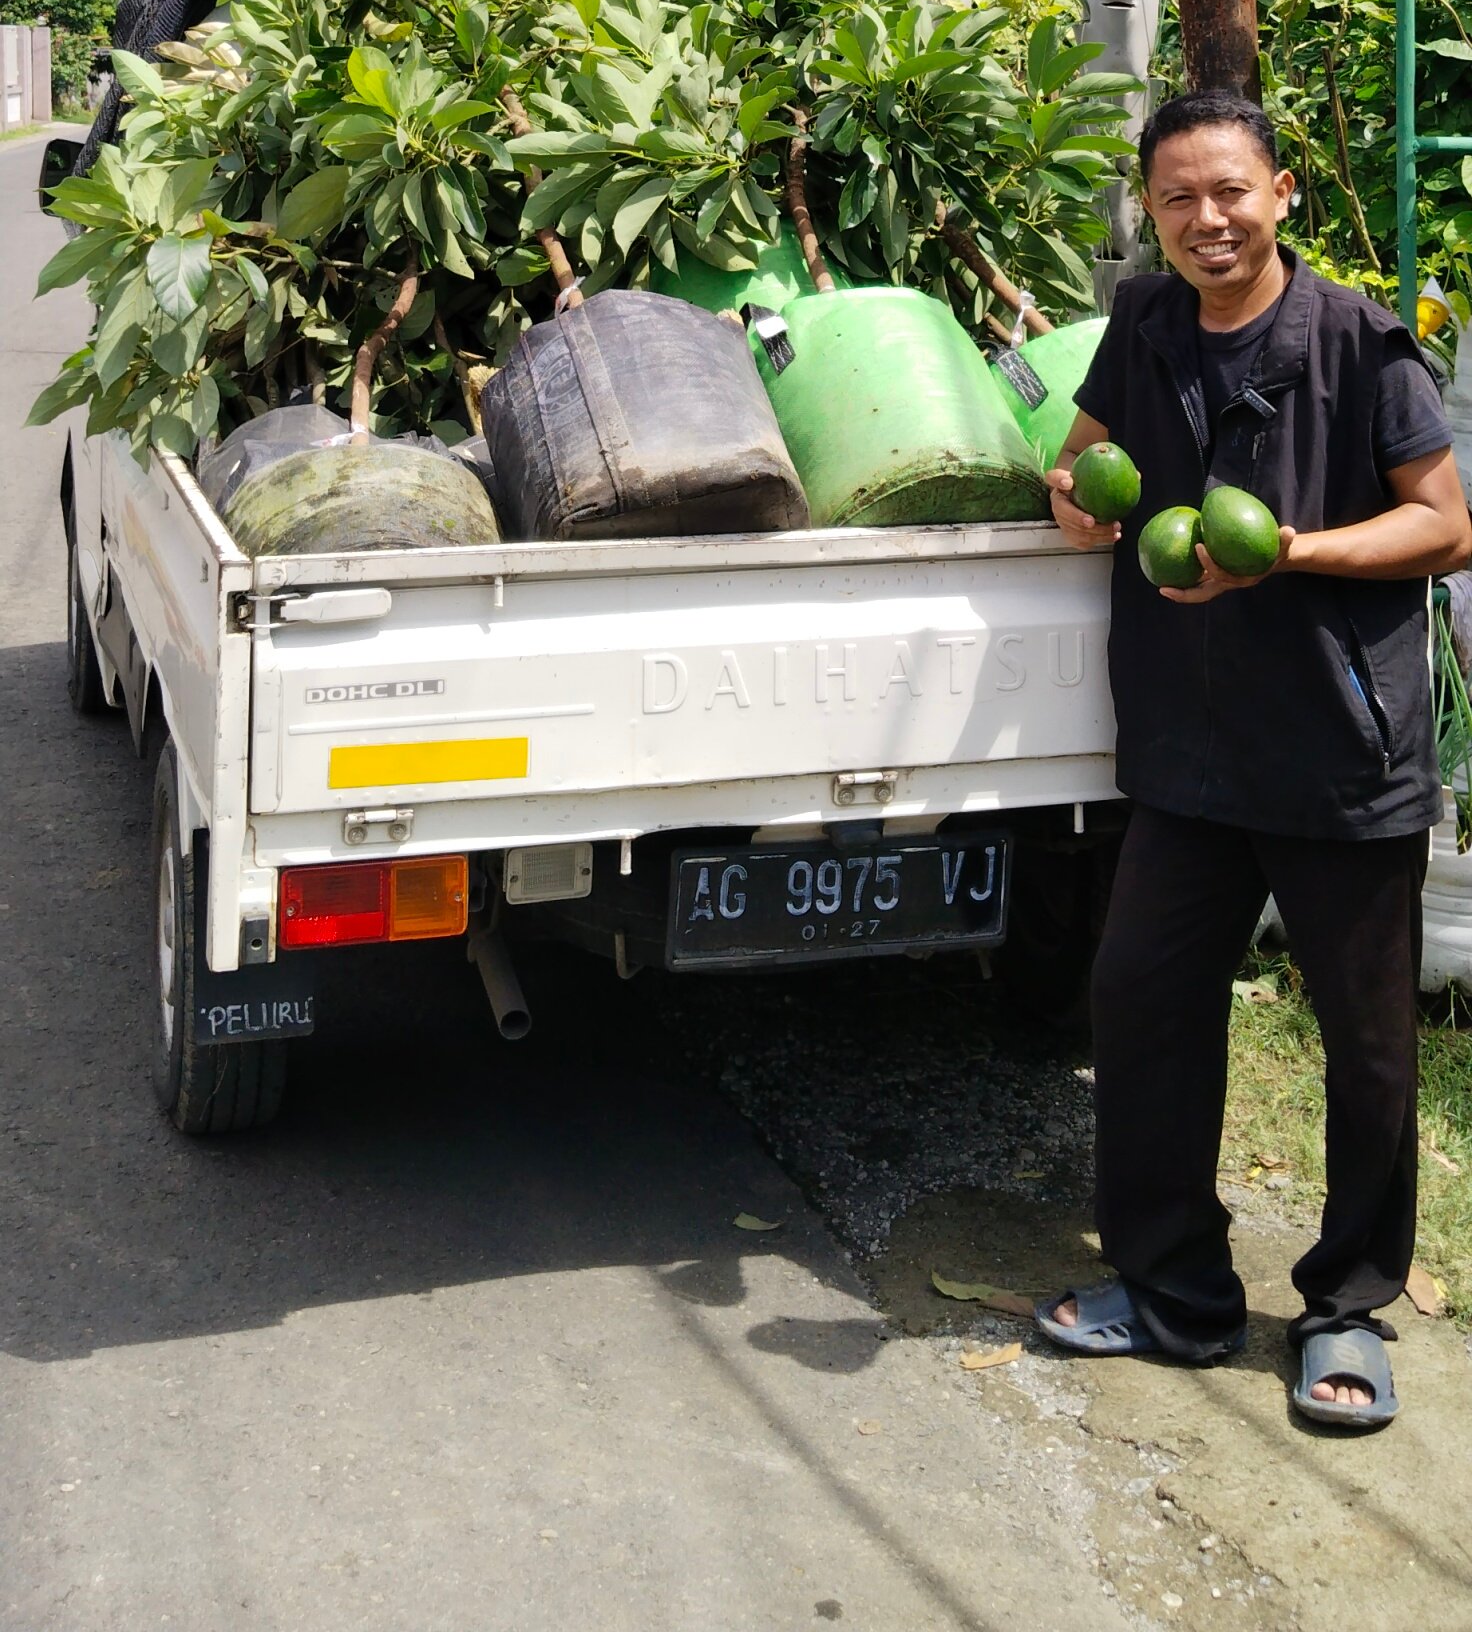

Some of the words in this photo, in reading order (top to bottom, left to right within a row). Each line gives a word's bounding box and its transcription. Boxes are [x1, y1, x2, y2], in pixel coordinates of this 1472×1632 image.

[306, 684, 388, 703] DOHC
[395, 680, 444, 696] DLI
[642, 631, 1085, 716] DAIHATSU
[689, 864, 748, 921] AG
[786, 854, 902, 917] 9975
[940, 846, 996, 905] VJ
